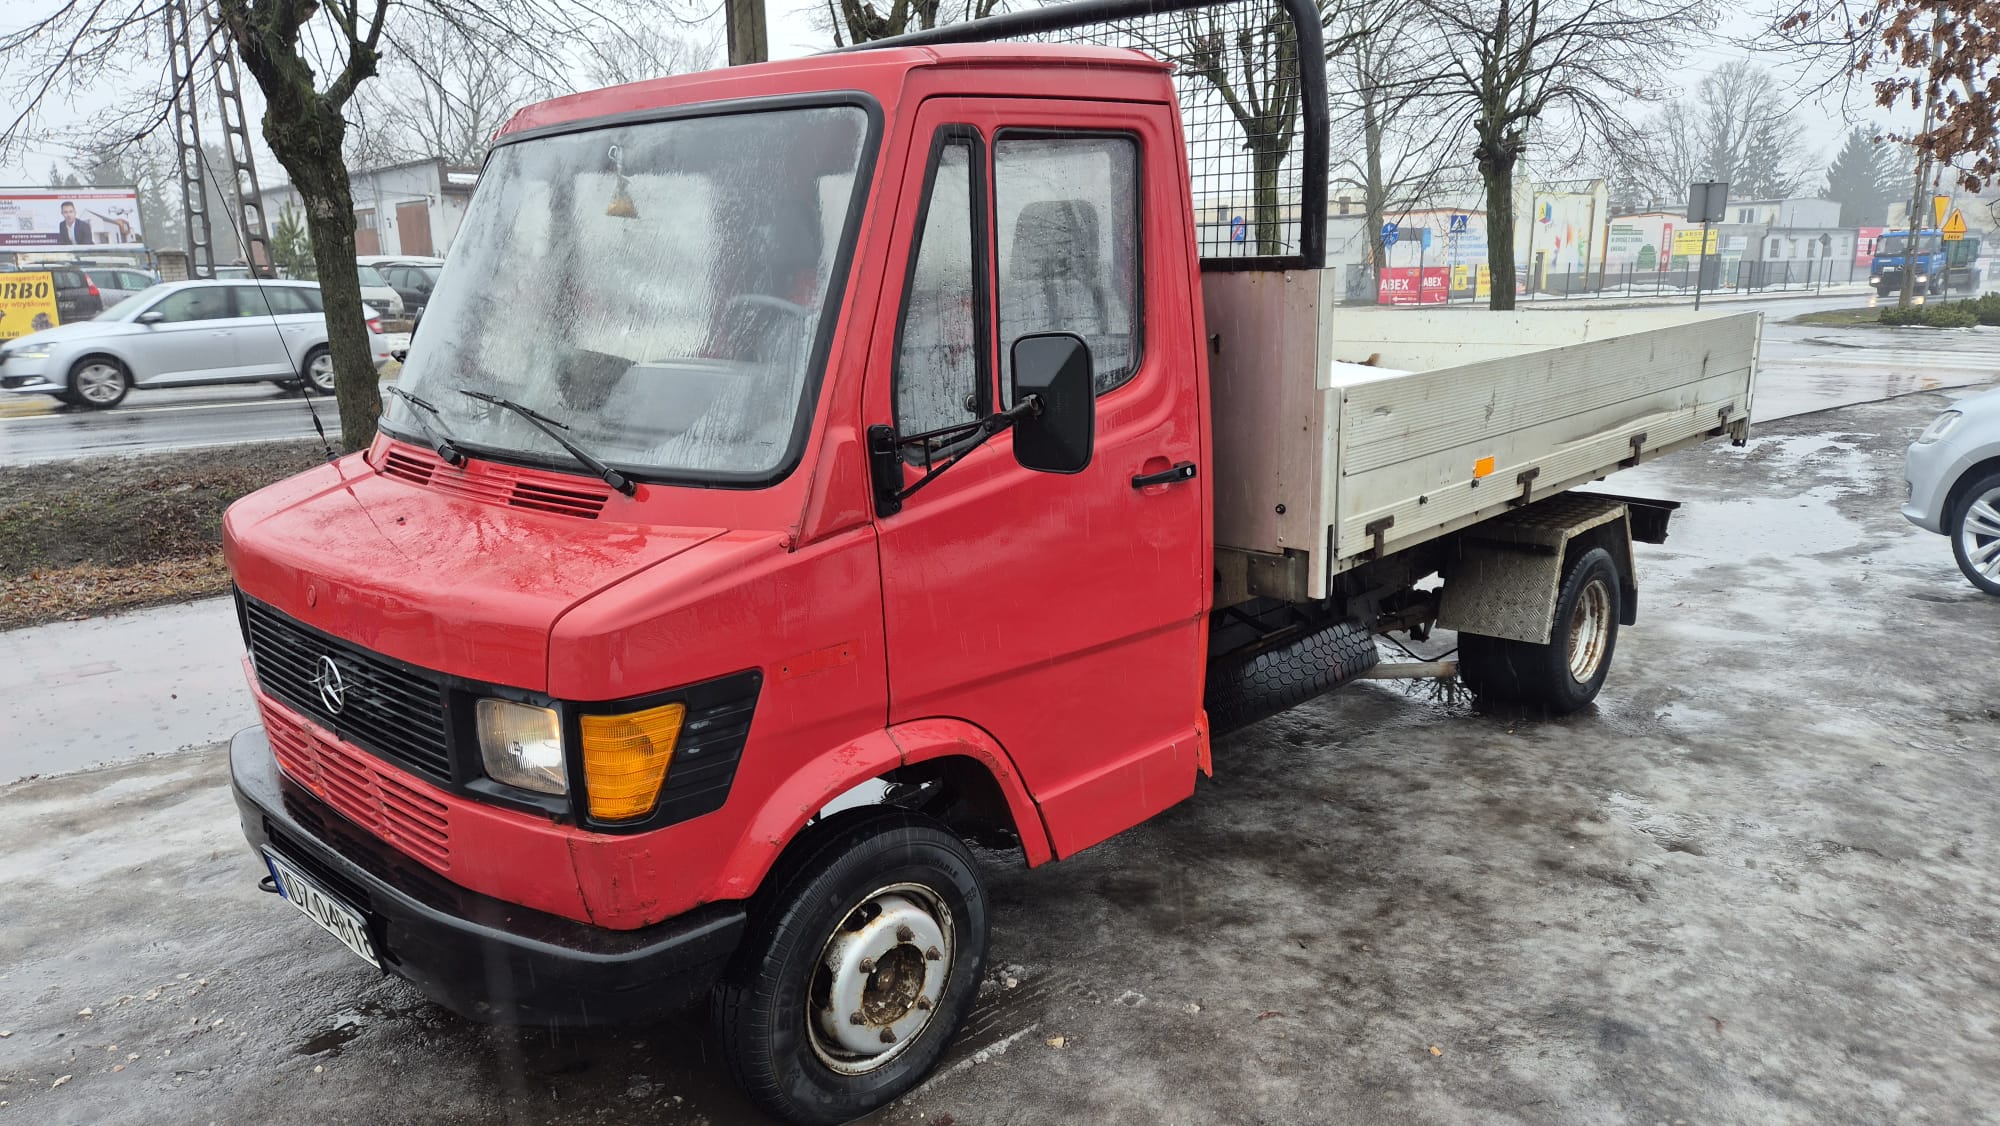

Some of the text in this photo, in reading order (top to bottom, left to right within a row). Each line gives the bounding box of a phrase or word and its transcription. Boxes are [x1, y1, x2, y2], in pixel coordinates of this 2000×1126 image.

[1380, 279, 1409, 290] ABEX
[1423, 277, 1442, 287] ABEX
[0, 282, 49, 299] RBO
